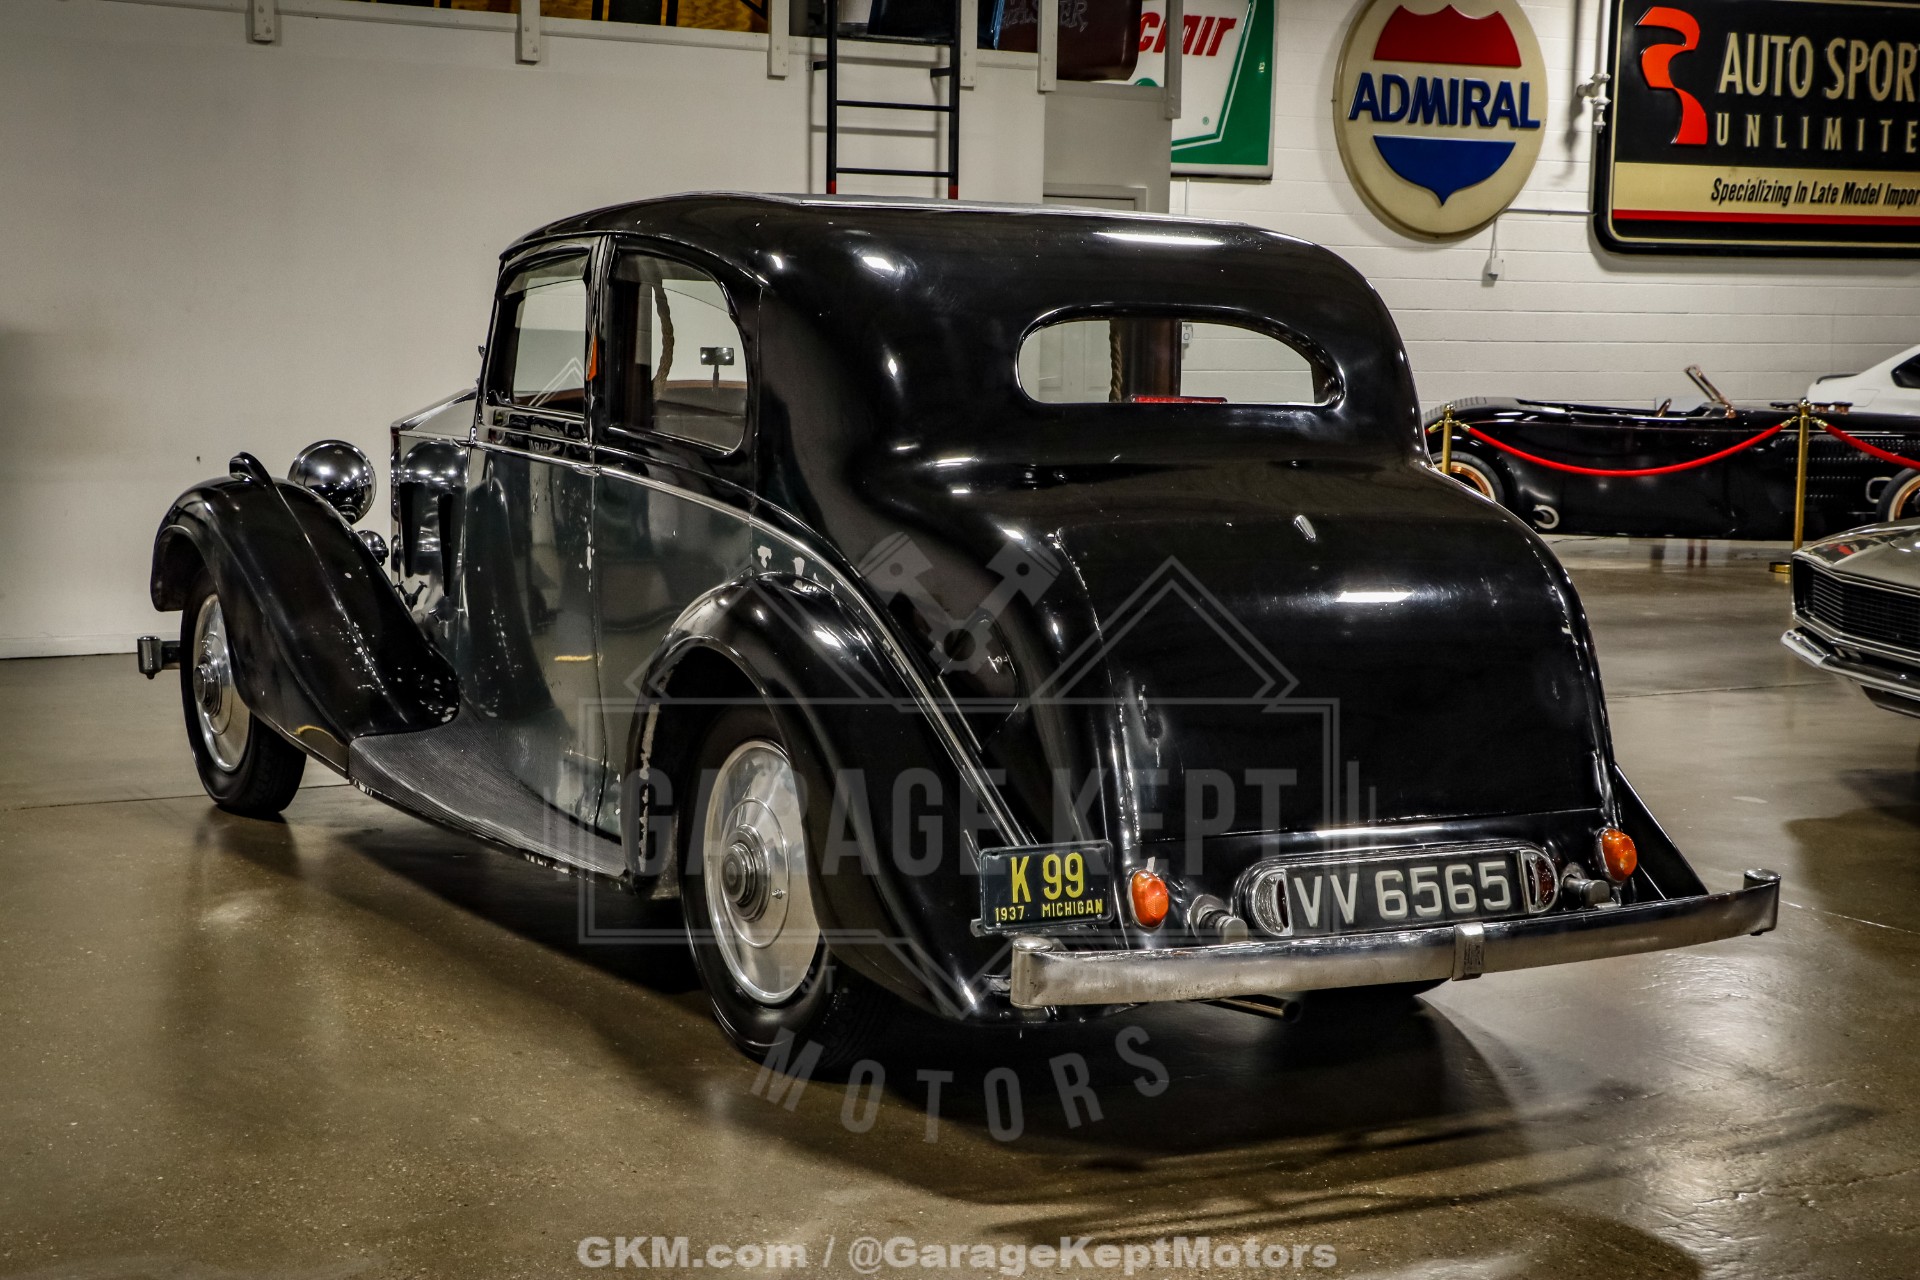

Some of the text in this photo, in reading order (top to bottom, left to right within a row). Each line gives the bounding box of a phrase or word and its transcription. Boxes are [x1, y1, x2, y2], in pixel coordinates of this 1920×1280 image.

[1717, 32, 1920, 103] AUTO SPOR
[1348, 72, 1541, 129] ADMIRAL
[1711, 177, 1793, 208] Specializing
[1794, 180, 1808, 204] In
[1810, 181, 1839, 205] Late
[1840, 181, 1883, 206] Model
[1011, 852, 1084, 904] K 99
[1294, 860, 1512, 928] VV 6565
[995, 898, 1103, 922] 1937 MICHIGAN
